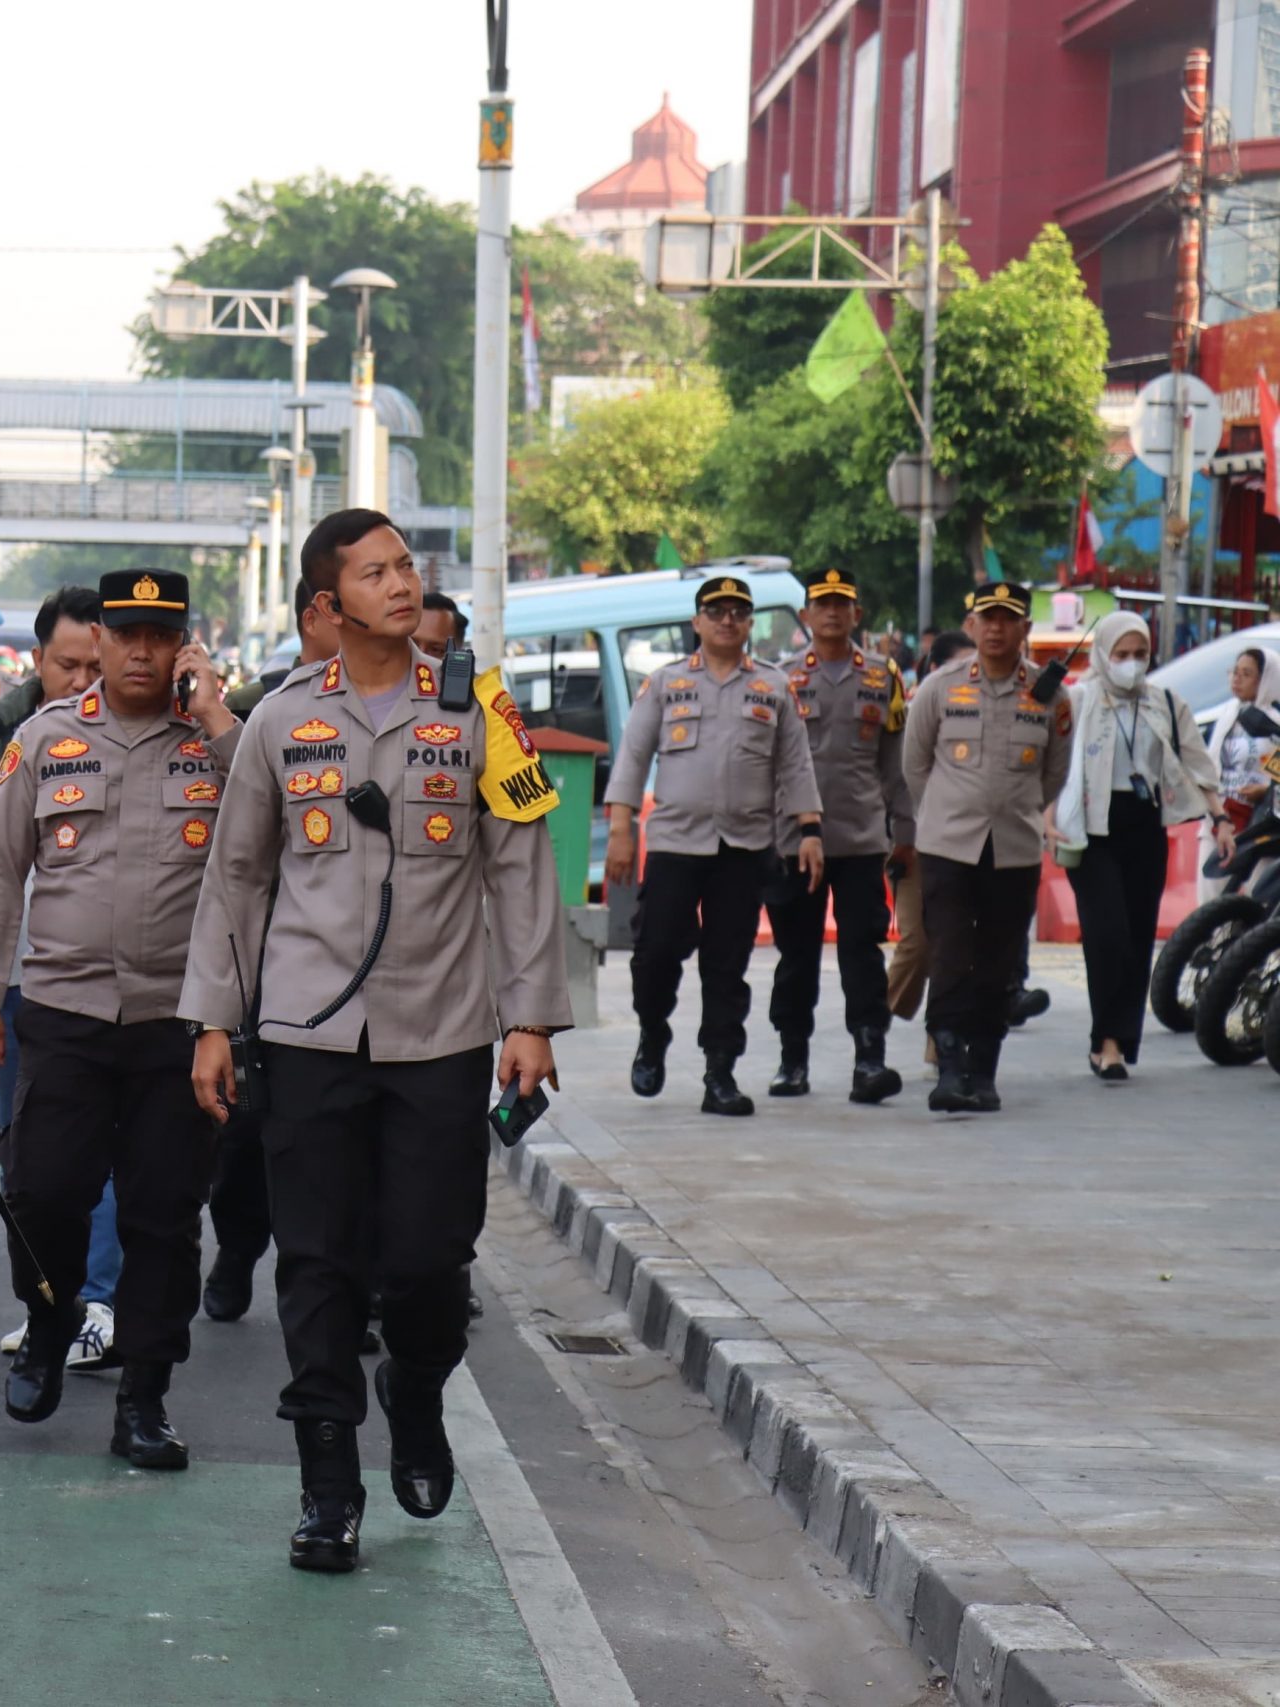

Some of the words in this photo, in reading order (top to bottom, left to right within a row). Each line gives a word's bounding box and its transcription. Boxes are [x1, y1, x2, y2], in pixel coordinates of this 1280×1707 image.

[666, 692, 699, 704] ADRI
[282, 743, 347, 767] WIRDHANTO
[407, 748, 471, 768] POLRI
[41, 760, 102, 781] BAMBANG
